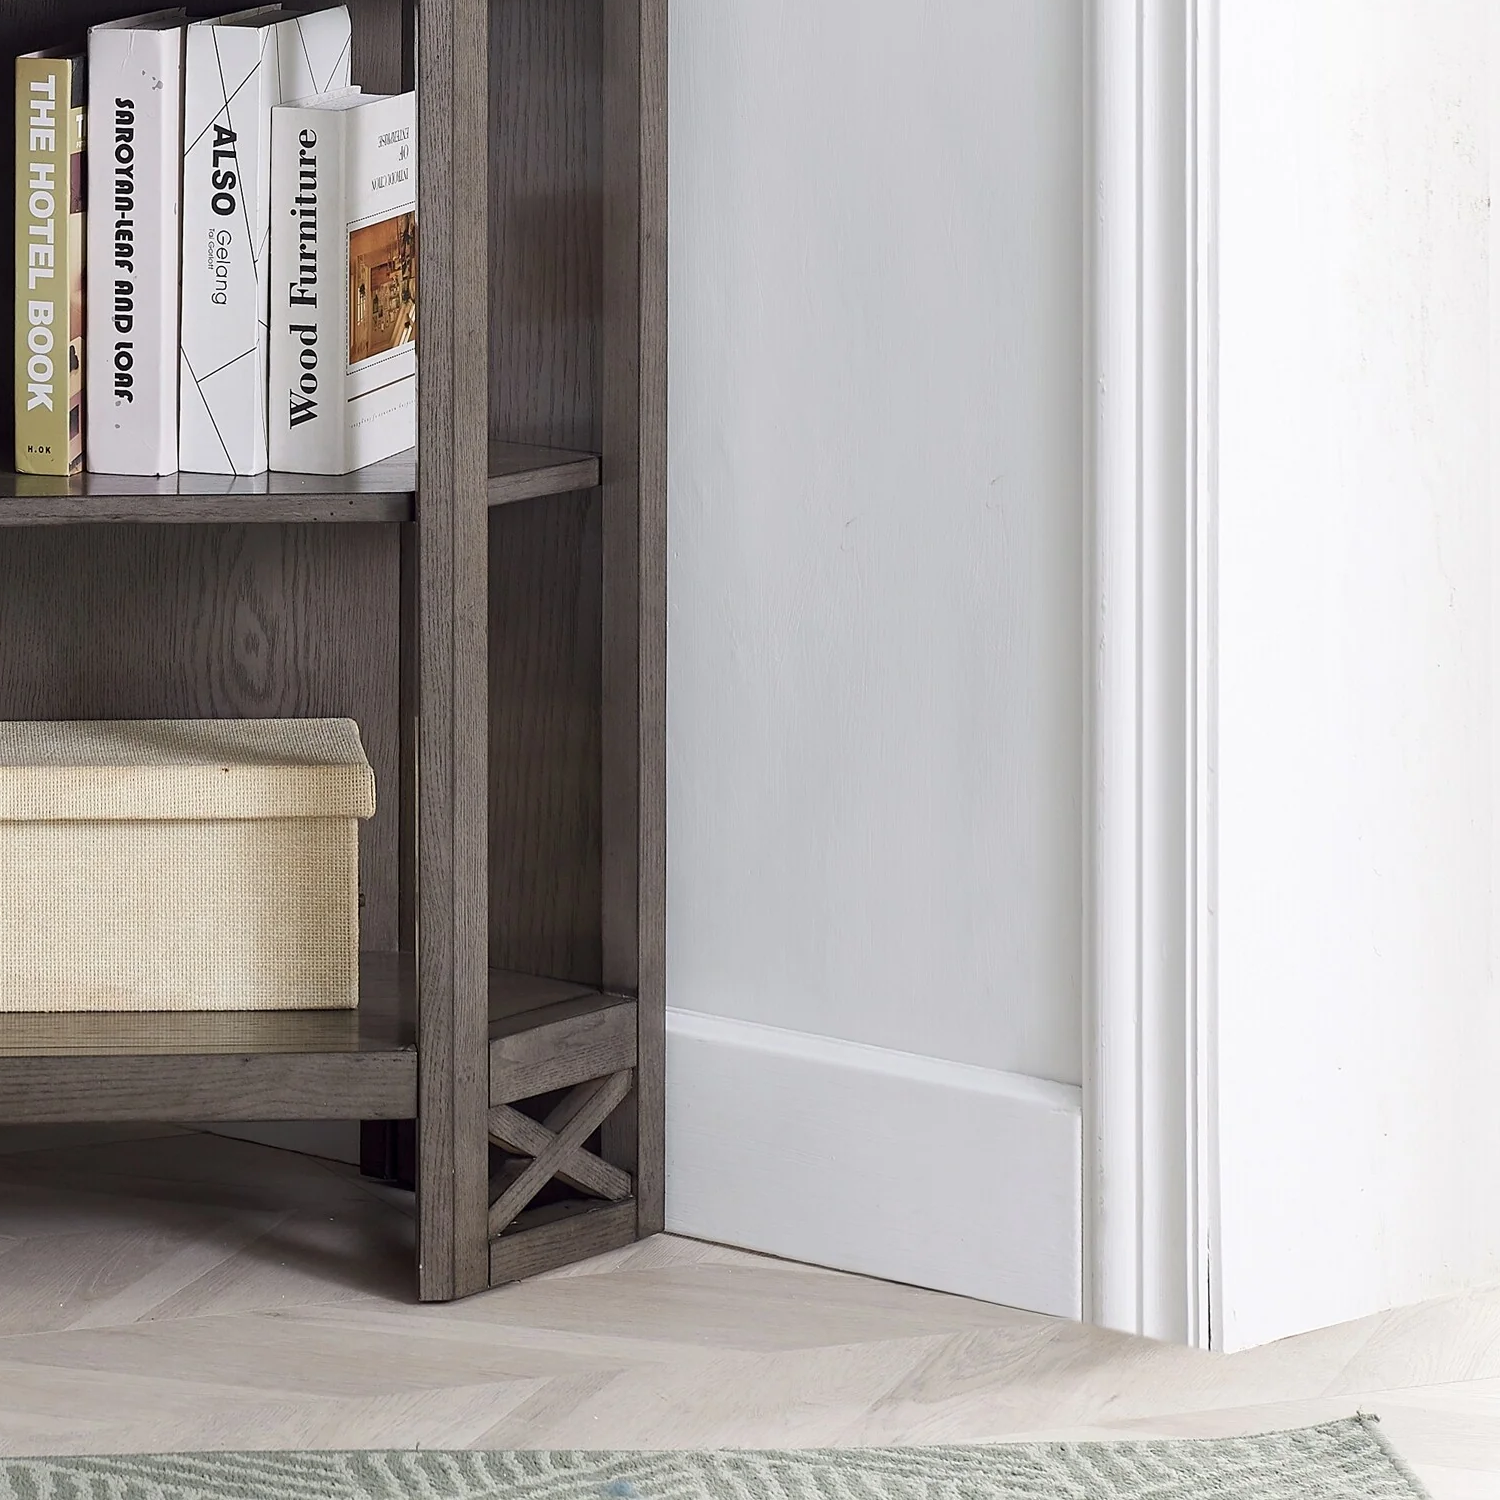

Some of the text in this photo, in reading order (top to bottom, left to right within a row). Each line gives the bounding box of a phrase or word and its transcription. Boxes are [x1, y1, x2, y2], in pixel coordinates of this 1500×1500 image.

[27, 75, 56, 412] THE HOTEL BOOK
[211, 124, 238, 305] ALSO Gelang
[398, 144, 410, 162] OF
[114, 280, 134, 334] AND
[288, 128, 319, 431] Wood Furniture
